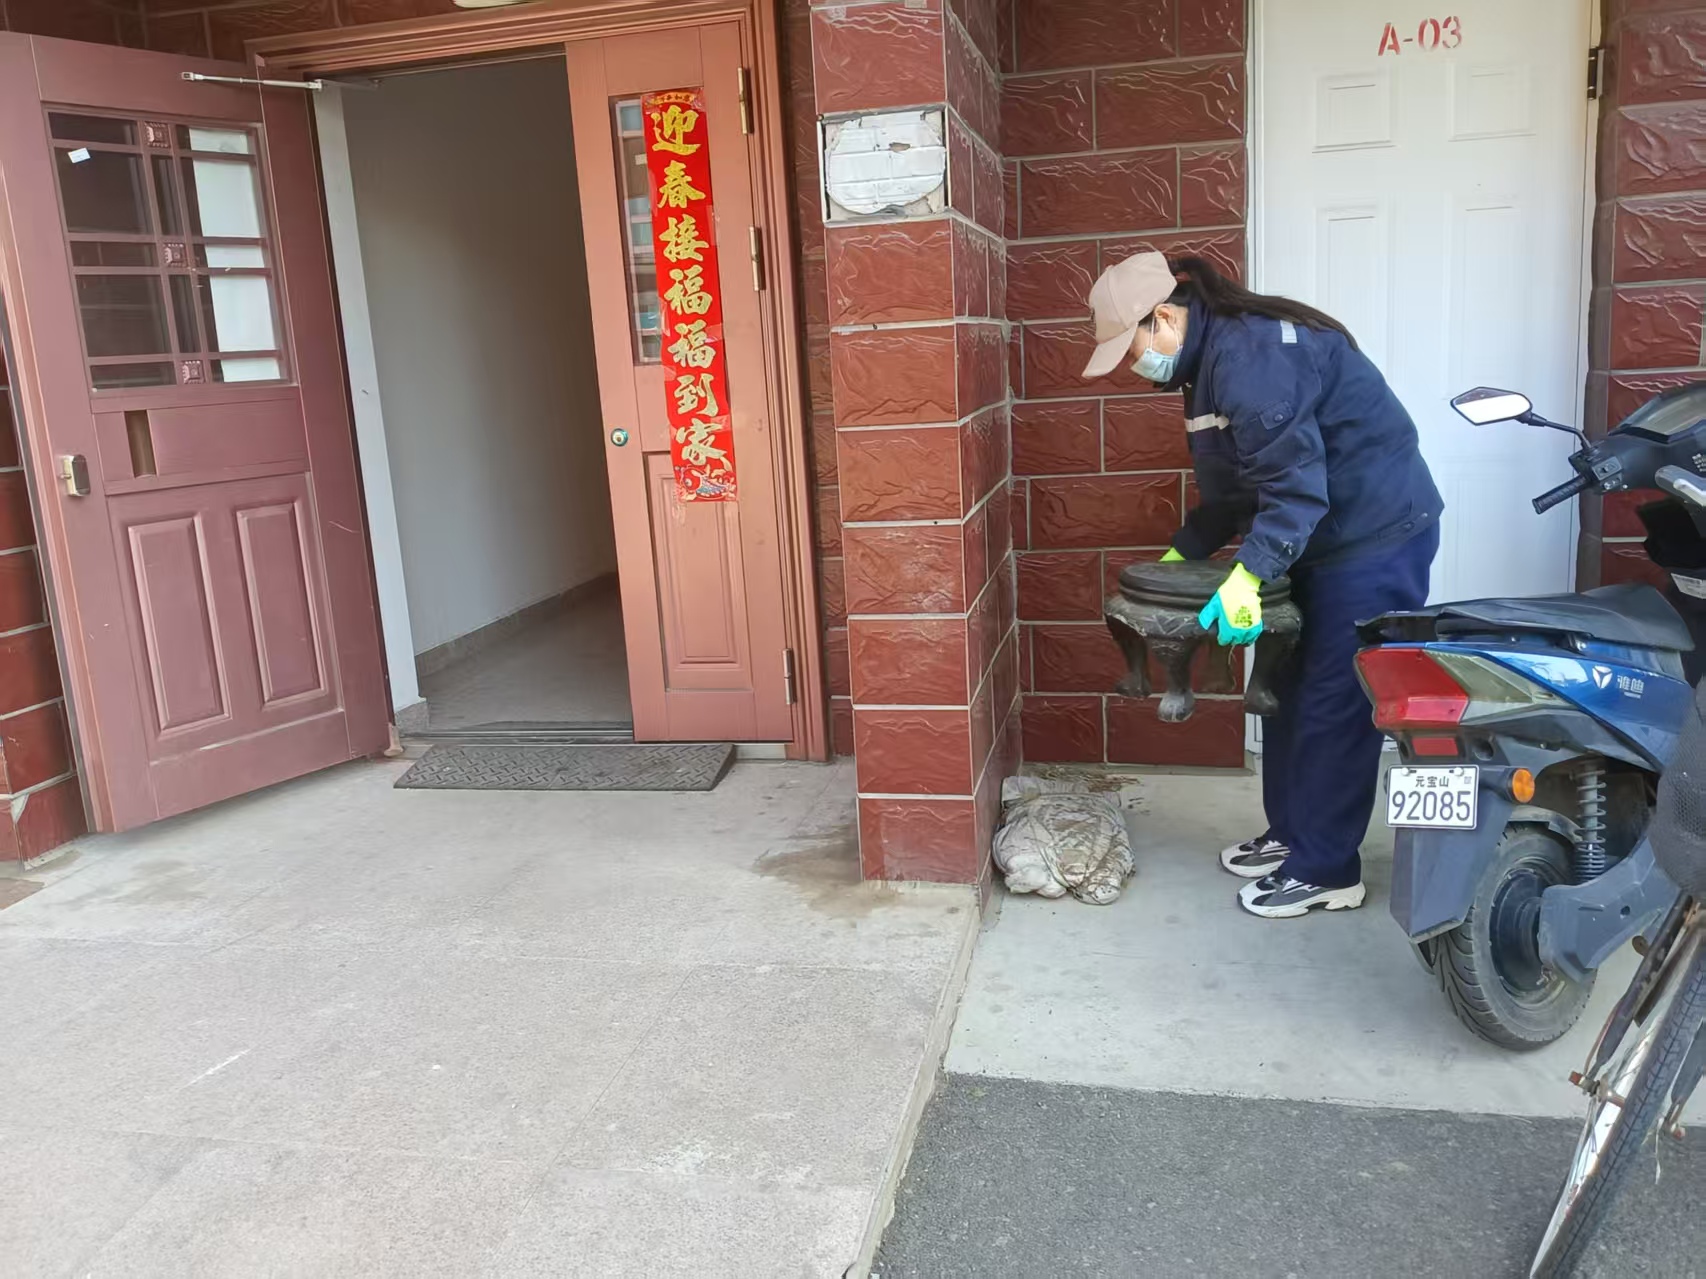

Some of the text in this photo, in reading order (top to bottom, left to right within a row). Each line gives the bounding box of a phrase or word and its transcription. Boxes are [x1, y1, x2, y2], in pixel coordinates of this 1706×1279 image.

[1378, 16, 1462, 56] A-03
[651, 104, 727, 465] 迎春接福福到家
[1415, 775, 1449, 788] 元宝山
[1392, 790, 1471, 821] 92085
